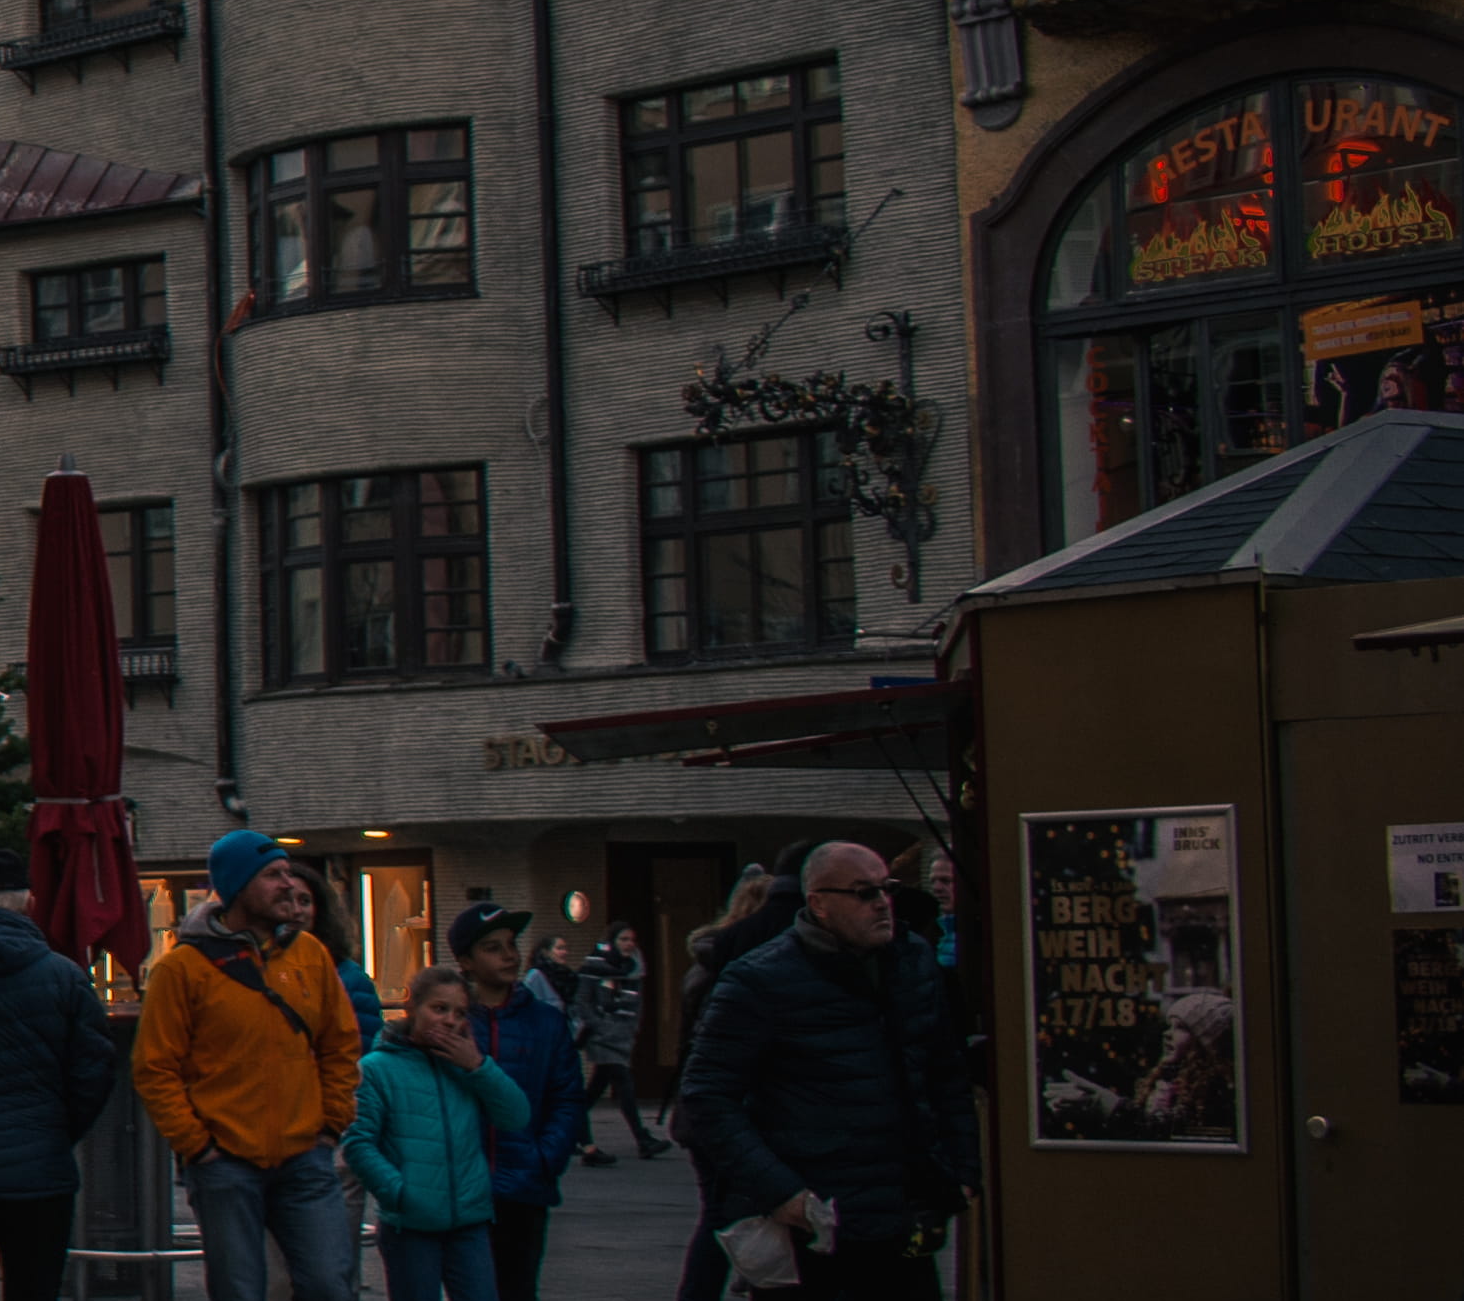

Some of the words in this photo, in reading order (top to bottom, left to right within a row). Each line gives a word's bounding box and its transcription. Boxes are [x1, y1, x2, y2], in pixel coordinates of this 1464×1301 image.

[1134, 250, 1259, 283] STEAK
[1319, 221, 1447, 255] HOUSE
[1172, 839, 1221, 851] BRUCK
[1418, 853, 1434, 864] NO
[1051, 894, 1139, 925] BERG
[1038, 928, 1122, 958] WEIH
[1060, 962, 1169, 993] NACHT
[1049, 995, 1138, 1030] 17/18
